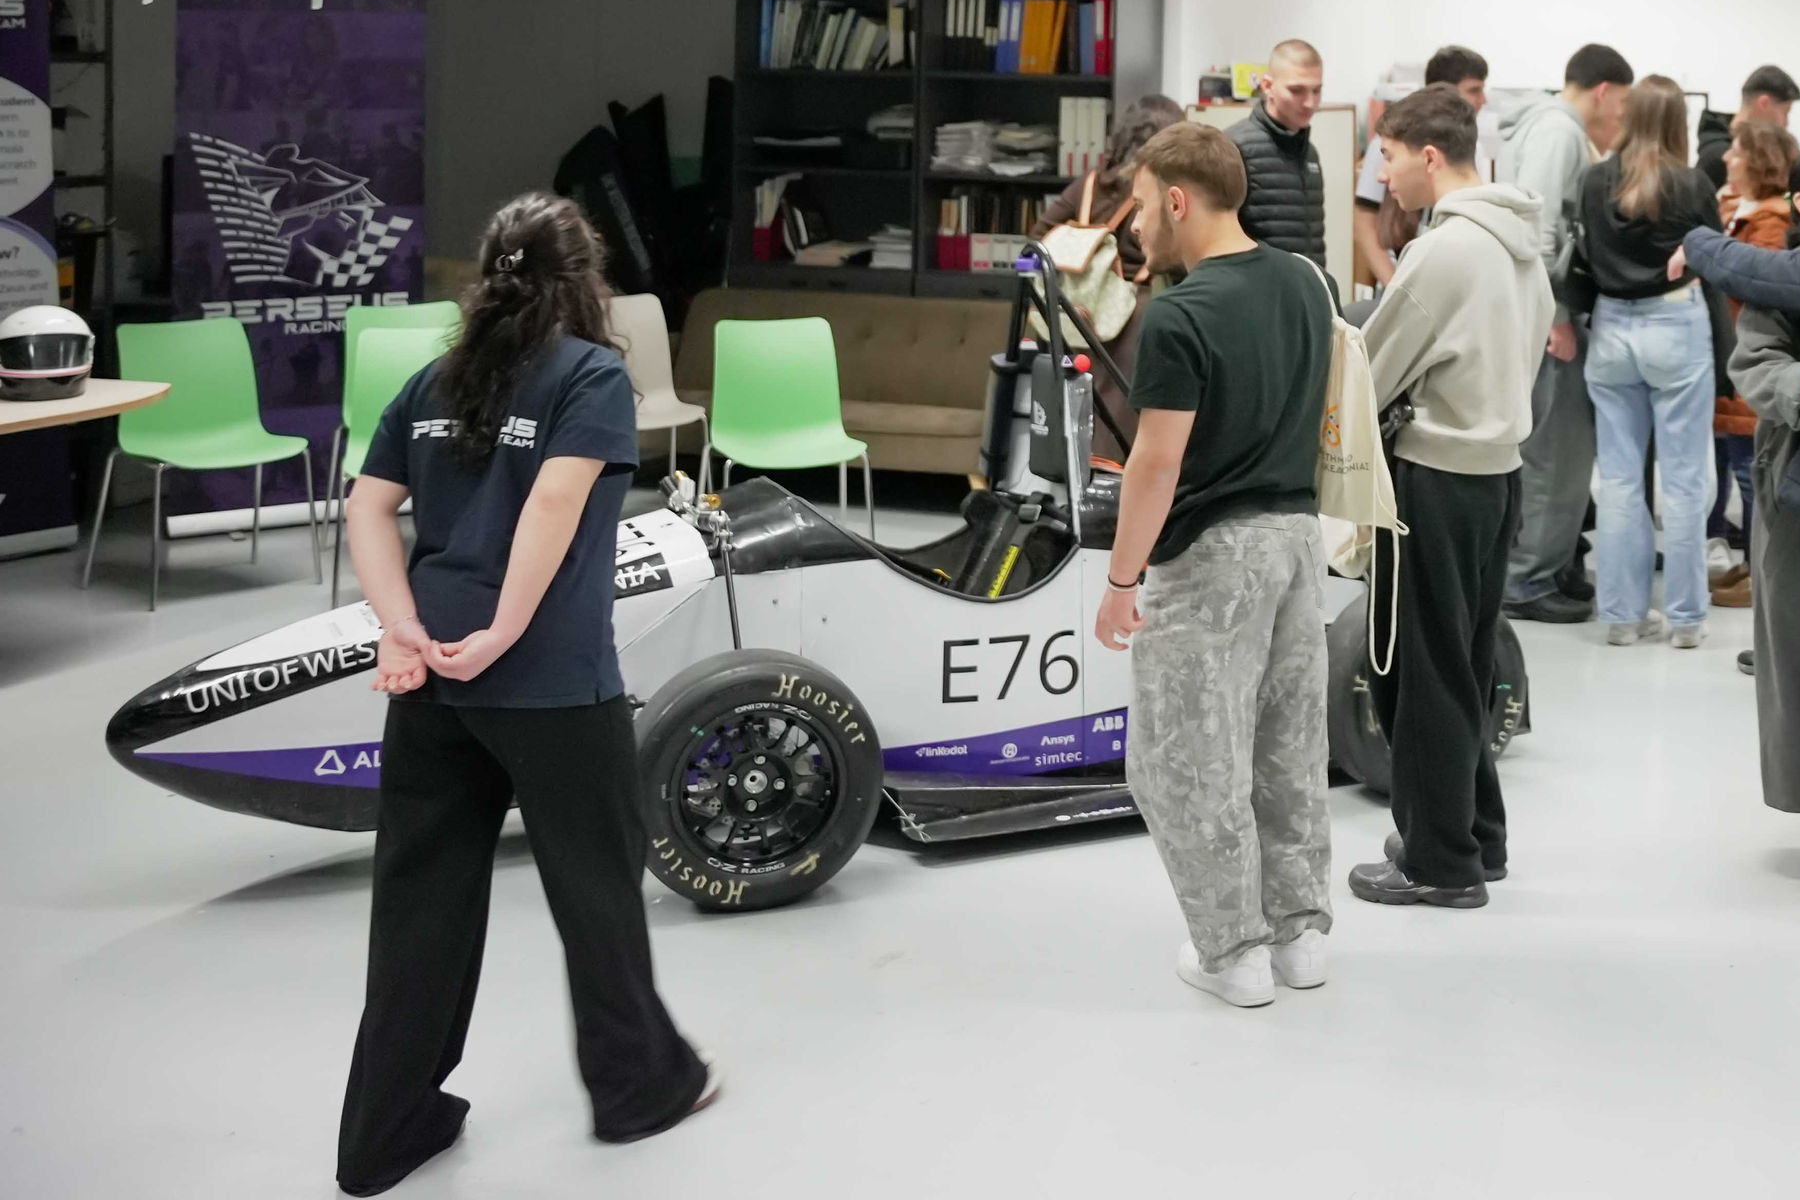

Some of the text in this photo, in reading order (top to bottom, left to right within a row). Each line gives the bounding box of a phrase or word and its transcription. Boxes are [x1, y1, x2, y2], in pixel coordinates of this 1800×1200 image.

[186, 640, 377, 714] UNI OF WES
[942, 630, 1079, 704] E76
[771, 673, 867, 745] Hoosier
[1092, 714, 1125, 733] ABB
[1034, 750, 1083, 767] simtec
[1040, 733, 1076, 747] Ansys
[653, 837, 751, 905] Hoosier
[741, 861, 786, 875] RACING
